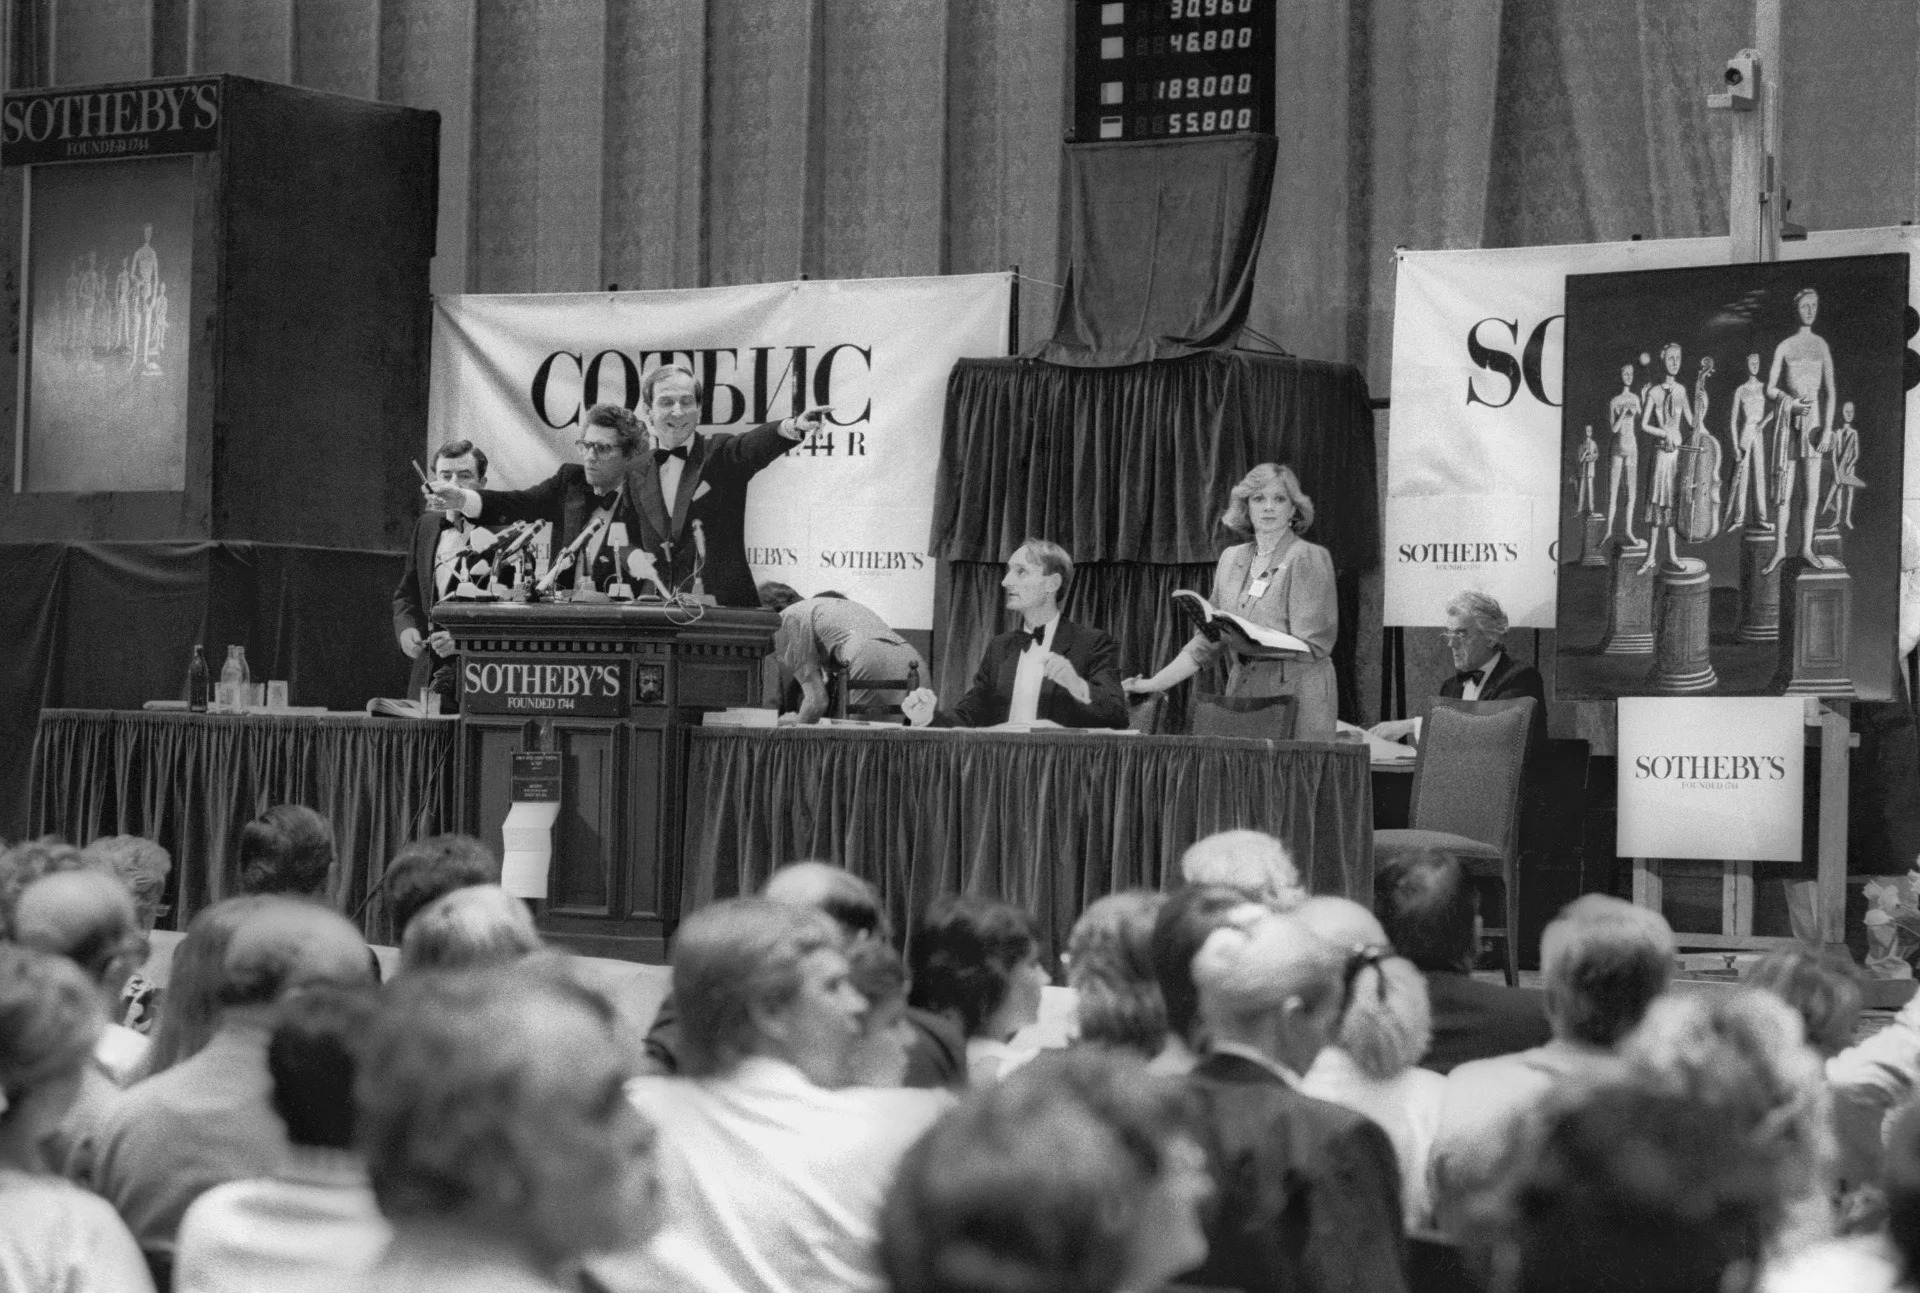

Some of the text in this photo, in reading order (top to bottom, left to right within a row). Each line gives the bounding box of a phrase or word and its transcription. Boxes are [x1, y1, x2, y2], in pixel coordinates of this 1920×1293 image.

[3, 84, 218, 144] SOTHEBY'S
[820, 550, 924, 570] SOTHEBY'S
[1398, 542, 1518, 564] SOTHEBY'S
[464, 663, 620, 697] SOTHEBY'S
[507, 697, 575, 710] FOUNDED 1744
[1635, 755, 1785, 780] SOTHEBY'S
